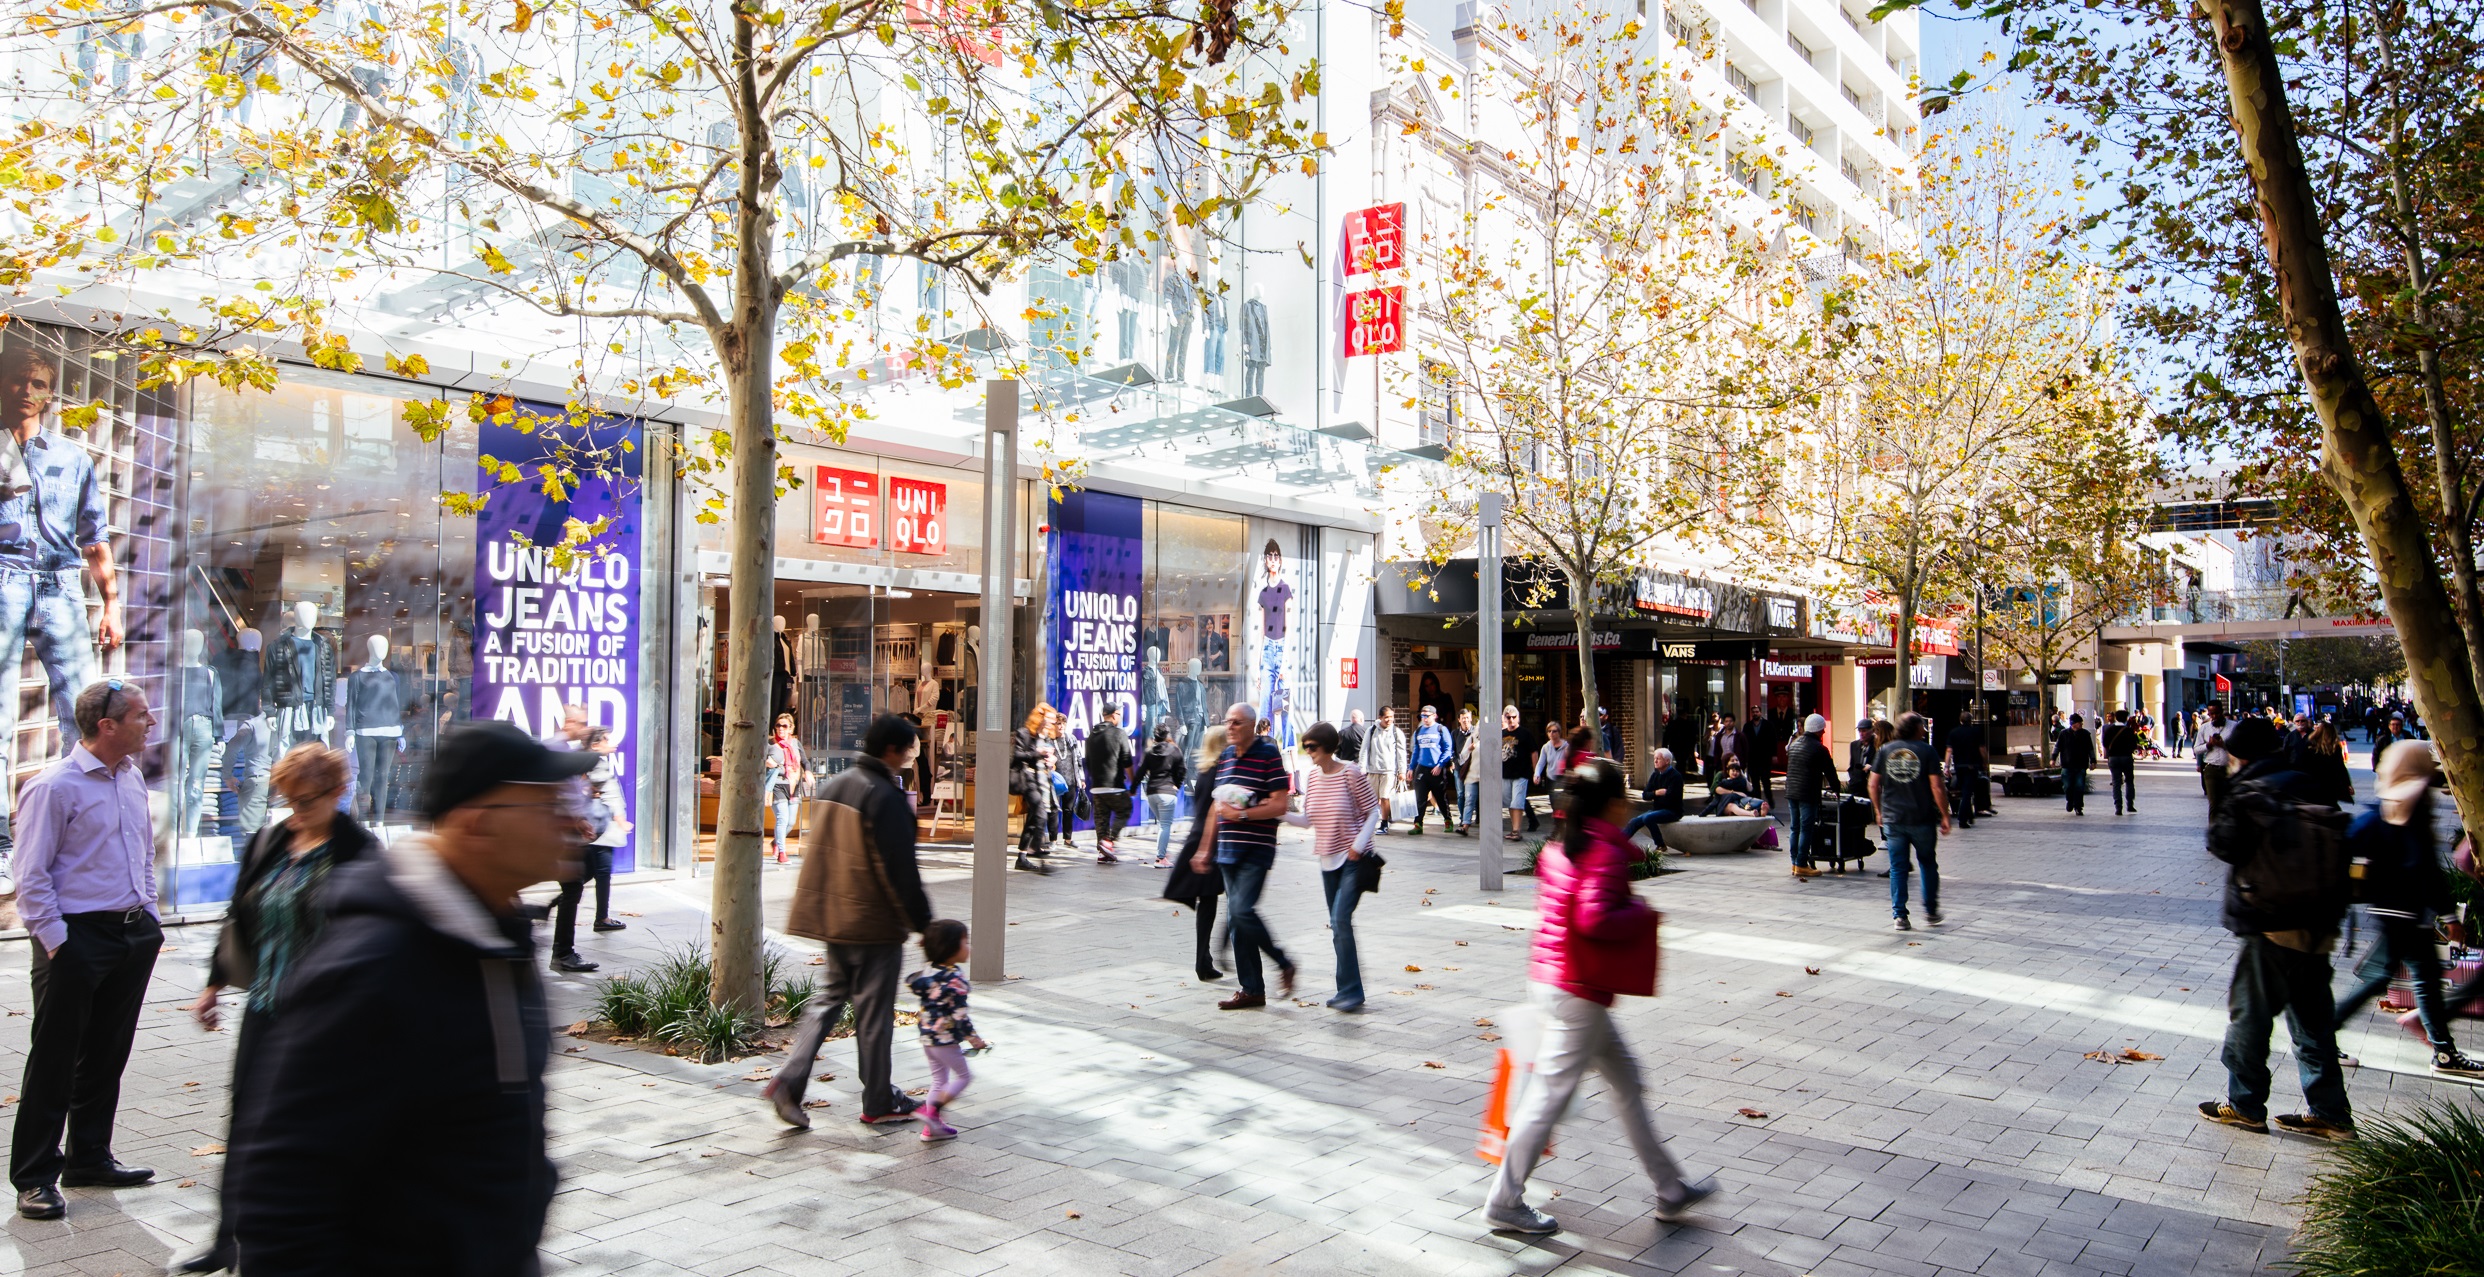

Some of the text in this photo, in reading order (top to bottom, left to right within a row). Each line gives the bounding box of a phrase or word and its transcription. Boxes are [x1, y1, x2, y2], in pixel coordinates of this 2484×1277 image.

[1352, 322, 1395, 352] QLO
[825, 477, 869, 506] ユニ
[897, 487, 936, 515] UNI
[823, 509, 869, 537] クロ
[897, 518, 939, 546] QLO
[488, 541, 629, 593] UNIQLO
[485, 587, 628, 632] JEANS
[1065, 590, 1137, 625] UNIQLO
[484, 631, 626, 657] A FUSION OF
[1064, 621, 1136, 654] JEANS
[1526, 631, 1621, 646] General Pts Co.
[1662, 644, 1696, 658] VANS
[483, 656, 627, 685] TRADITION
[1063, 652, 1136, 670] A FUSION OF
[1342, 661, 1355, 672] UNI
[1765, 661, 1812, 678] FLIGHT CENTRE
[1805, 651, 1841, 662] Locker
[1063, 670, 1136, 691] TRADITION
[1342, 673, 1356, 686] QLO
[1909, 665, 1932, 684] HYPE
[492, 686, 627, 750] AND
[1065, 691, 1137, 739] AND
